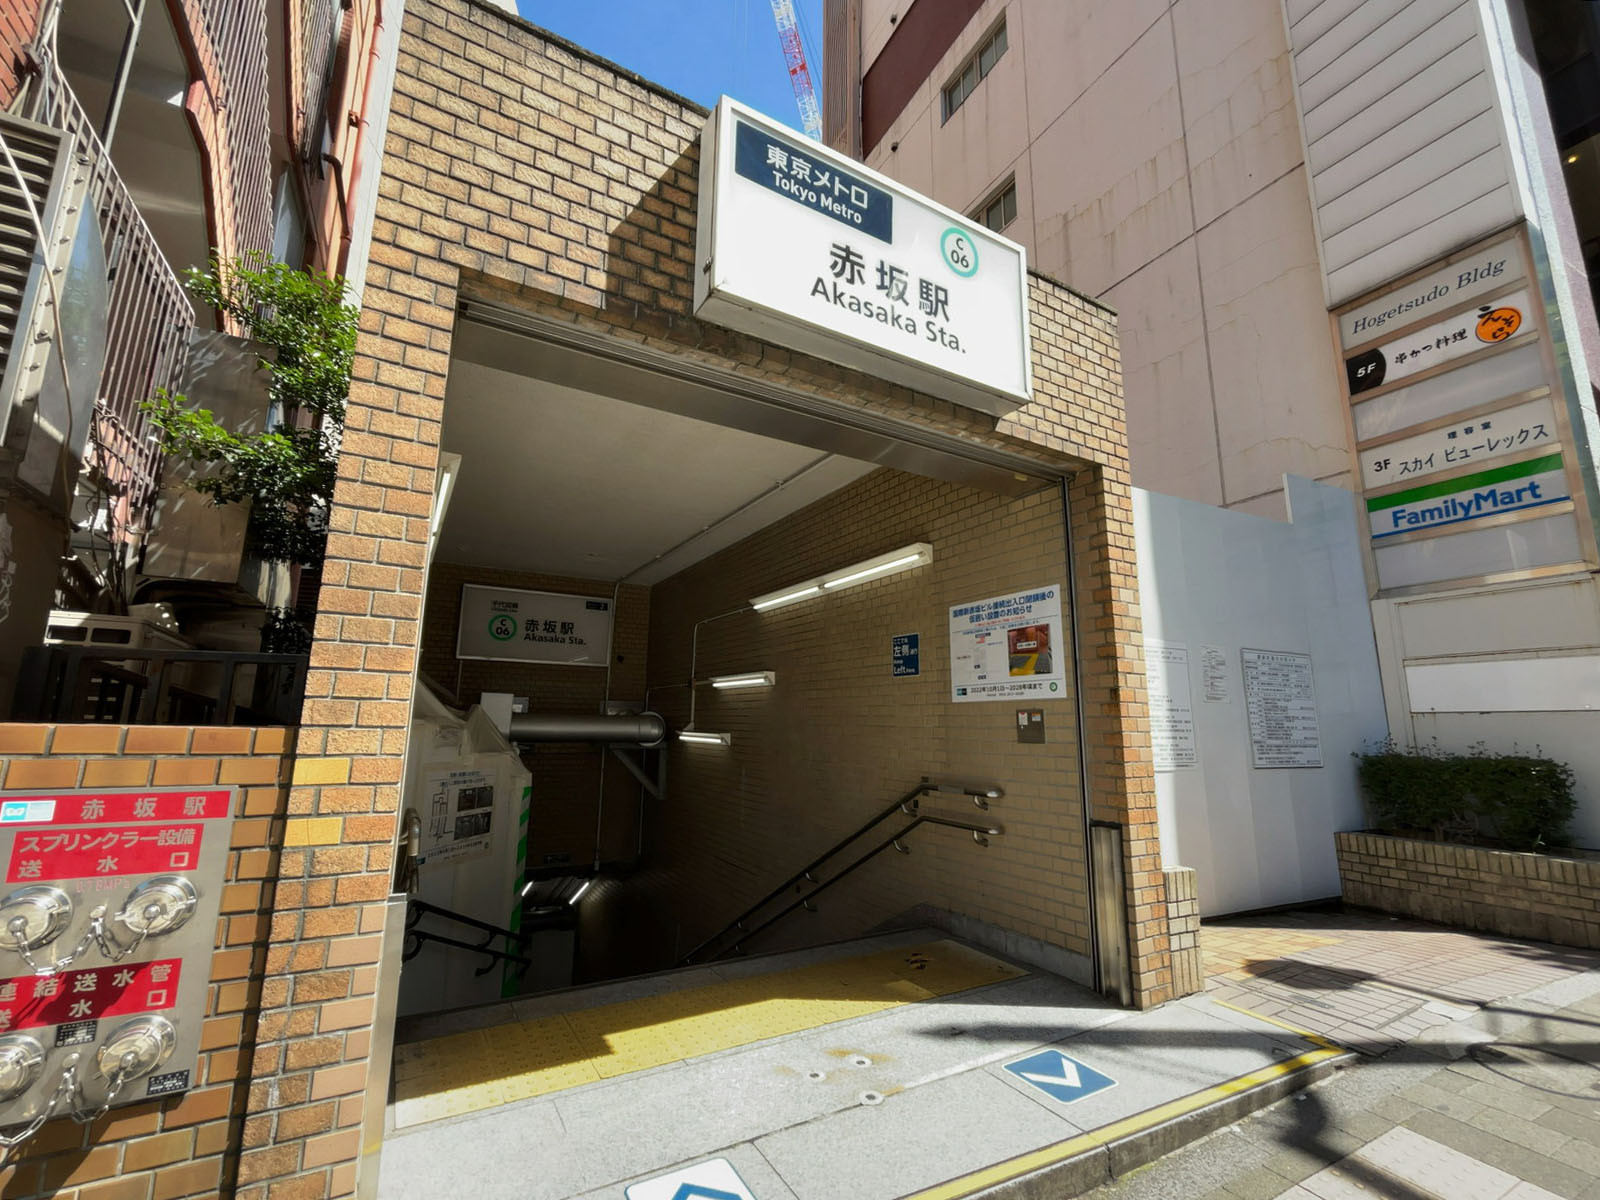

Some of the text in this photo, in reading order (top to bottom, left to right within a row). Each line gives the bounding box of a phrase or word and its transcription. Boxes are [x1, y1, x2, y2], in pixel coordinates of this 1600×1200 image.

[766, 144, 868, 209] 東京メトロ
[772, 170, 862, 224] Tokyo Metro
[956, 237, 964, 251] C
[950, 249, 970, 268] 06
[829, 242, 950, 322] 赤坂駅
[1352, 259, 1507, 335] Hogetsudo Bldg
[810, 276, 967, 354] Akasaka Sta.
[1394, 328, 1468, 364] 串かつ料理
[1356, 362, 1377, 378] 5F
[1374, 458, 1391, 473] 3F
[1399, 453, 1435, 475] スカイ
[1392, 481, 1543, 528] FamilyMart
[495, 626, 510, 636] 06
[500, 619, 507, 627] C
[524, 619, 575, 635] 赤坂駅
[523, 633, 587, 646] Akasaka Sta.
[81, 796, 207, 820] 赤坂駅
[19, 828, 196, 853] スプリンクラー設備
[18, 852, 190, 879] 送水口
